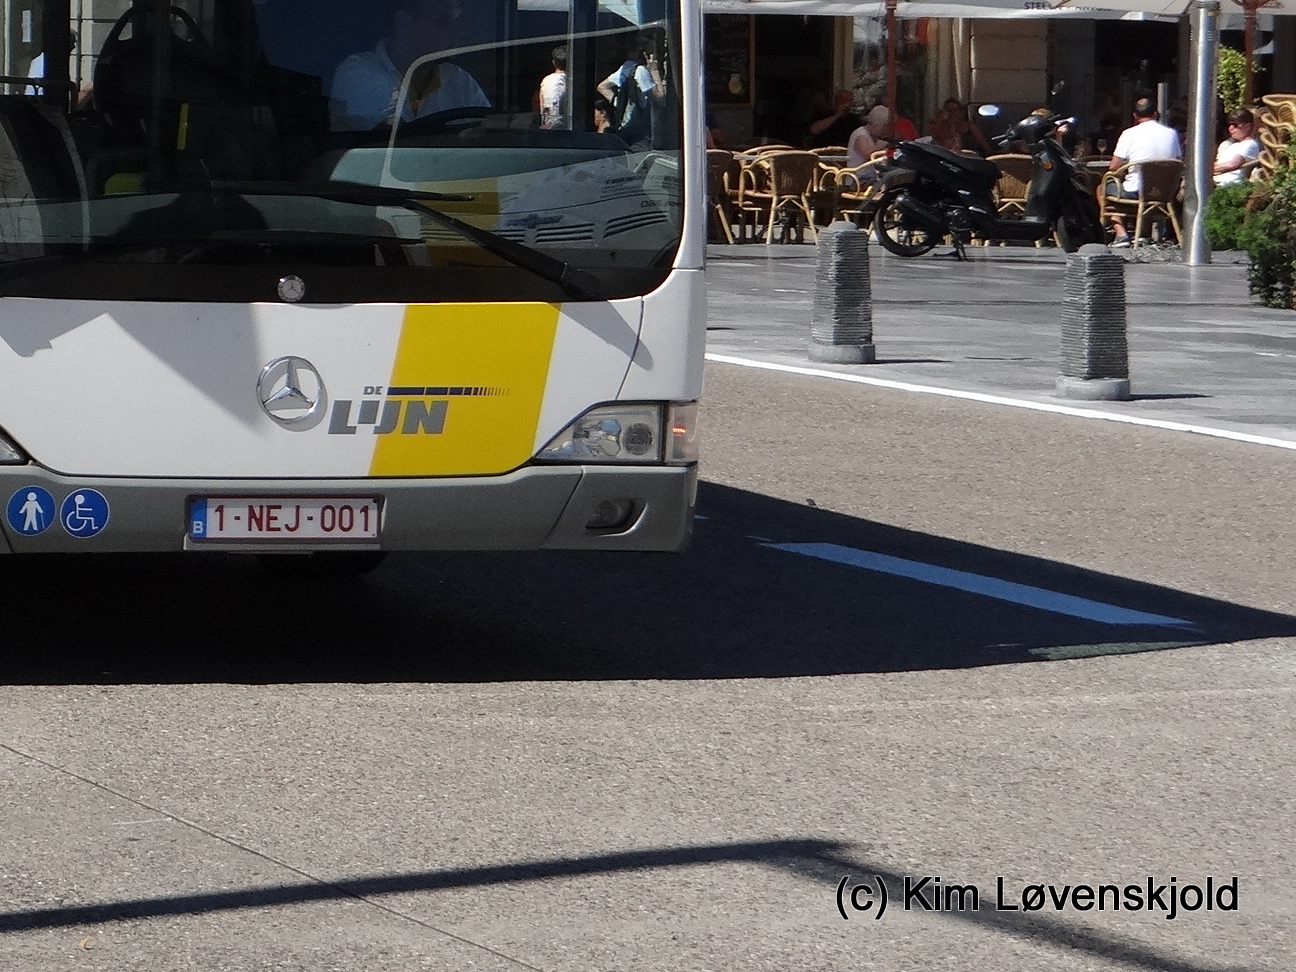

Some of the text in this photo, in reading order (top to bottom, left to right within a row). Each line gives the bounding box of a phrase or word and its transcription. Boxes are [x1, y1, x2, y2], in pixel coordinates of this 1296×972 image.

[363, 385, 383, 396] DE
[327, 399, 450, 435] LIJN
[192, 504, 370, 534] B 1-NEJ-001
